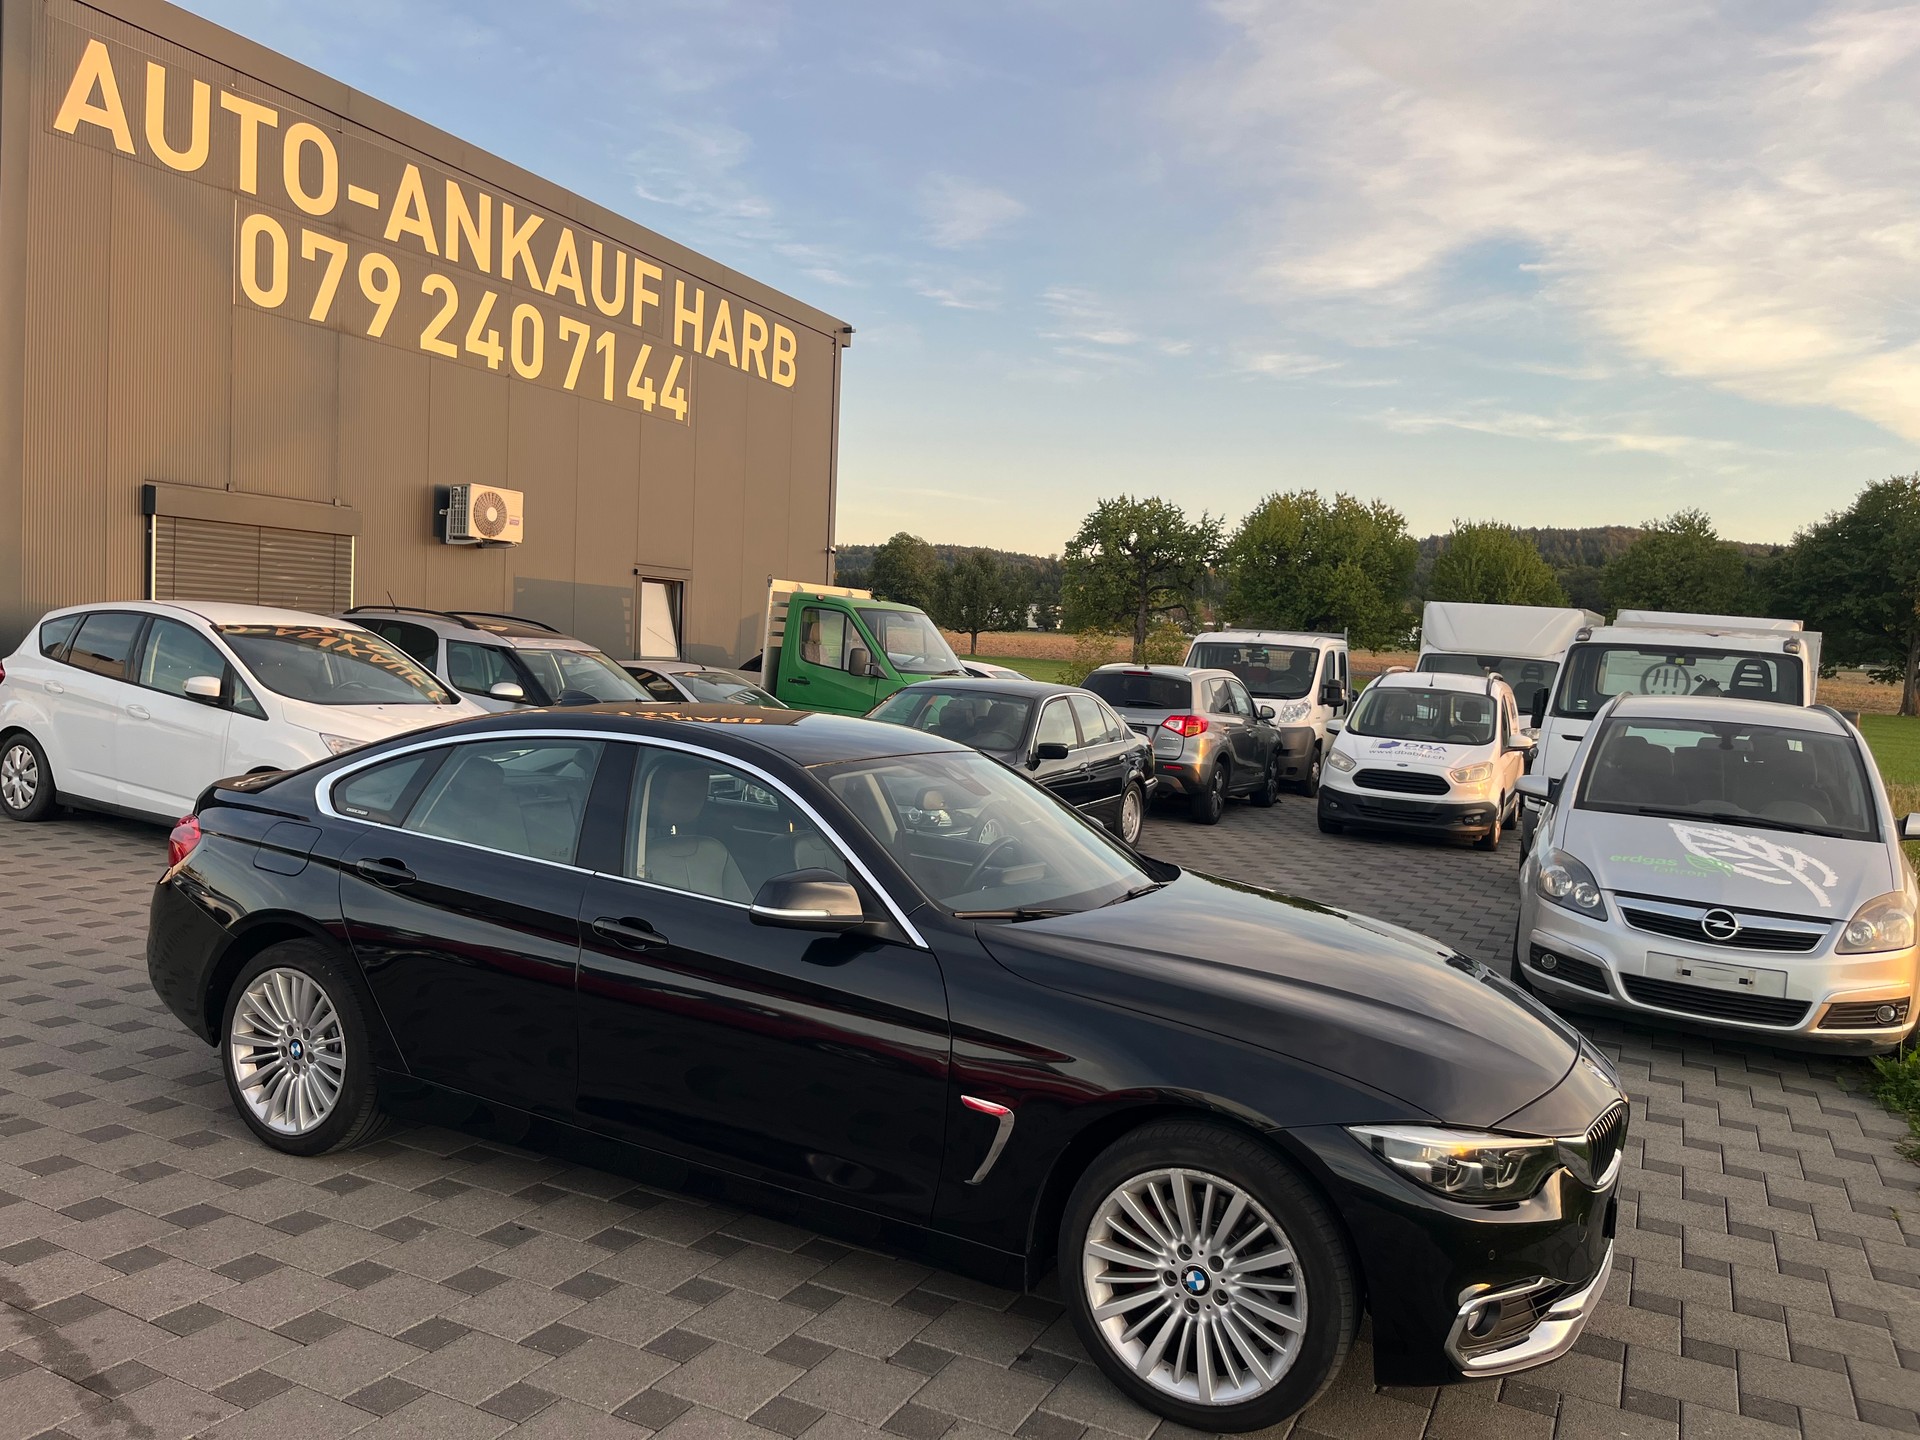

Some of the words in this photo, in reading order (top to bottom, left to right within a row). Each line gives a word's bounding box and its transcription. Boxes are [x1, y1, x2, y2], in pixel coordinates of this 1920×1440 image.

[53, 39, 662, 327] AUTO-ANKAUF
[673, 279, 797, 388] HARB
[239, 213, 401, 338] 079
[419, 273, 545, 380] 240
[1404, 743, 1447, 752] DBA
[1609, 854, 1679, 866] erdgas
